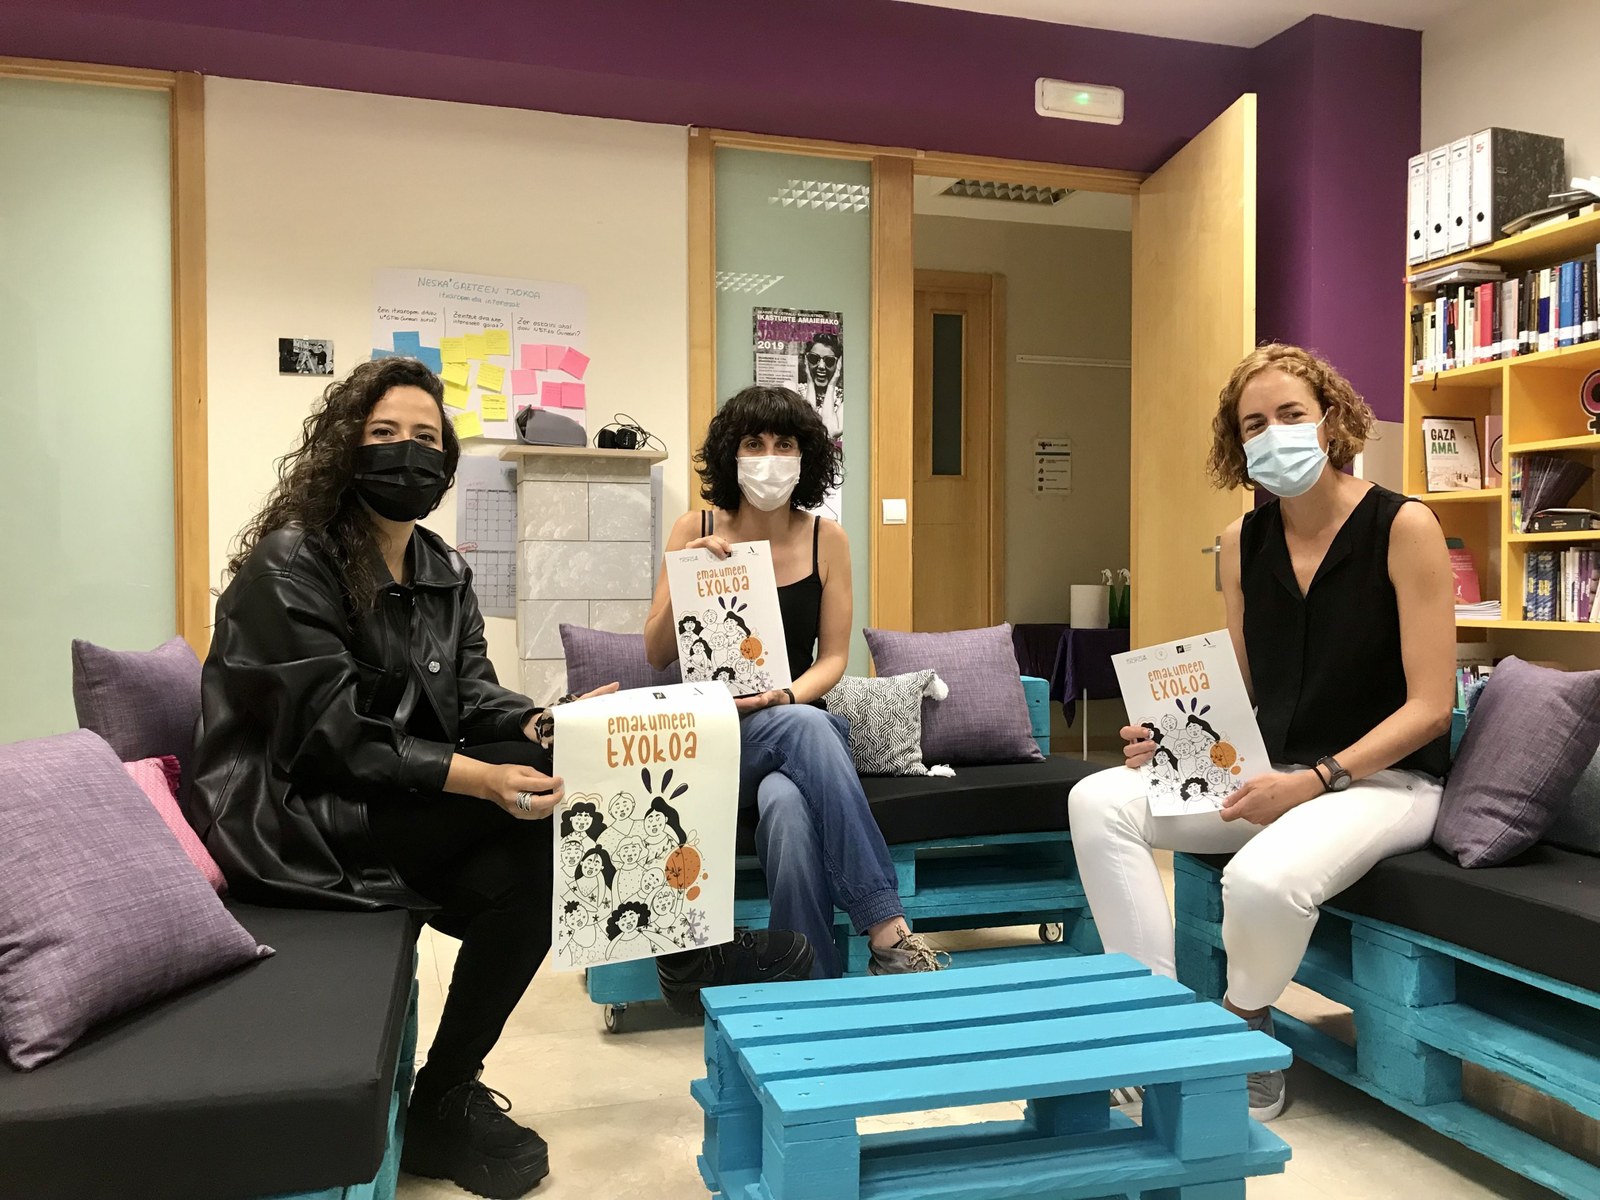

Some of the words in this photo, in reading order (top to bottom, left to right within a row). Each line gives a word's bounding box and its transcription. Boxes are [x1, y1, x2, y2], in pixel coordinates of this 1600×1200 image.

[757, 314, 796, 323] IKASTURTE
[797, 316, 839, 326] AMAIERAKO
[758, 341, 784, 350] 2019
[1431, 428, 1456, 441] GAZA
[1431, 442, 1459, 454] AMAL
[696, 564, 747, 580] emakumeen
[697, 575, 750, 598] txokoa
[1148, 661, 1205, 682] emakumeen
[1150, 673, 1210, 702] txokoa
[607, 711, 696, 735] emakumeen
[606, 731, 698, 768] txokoa
